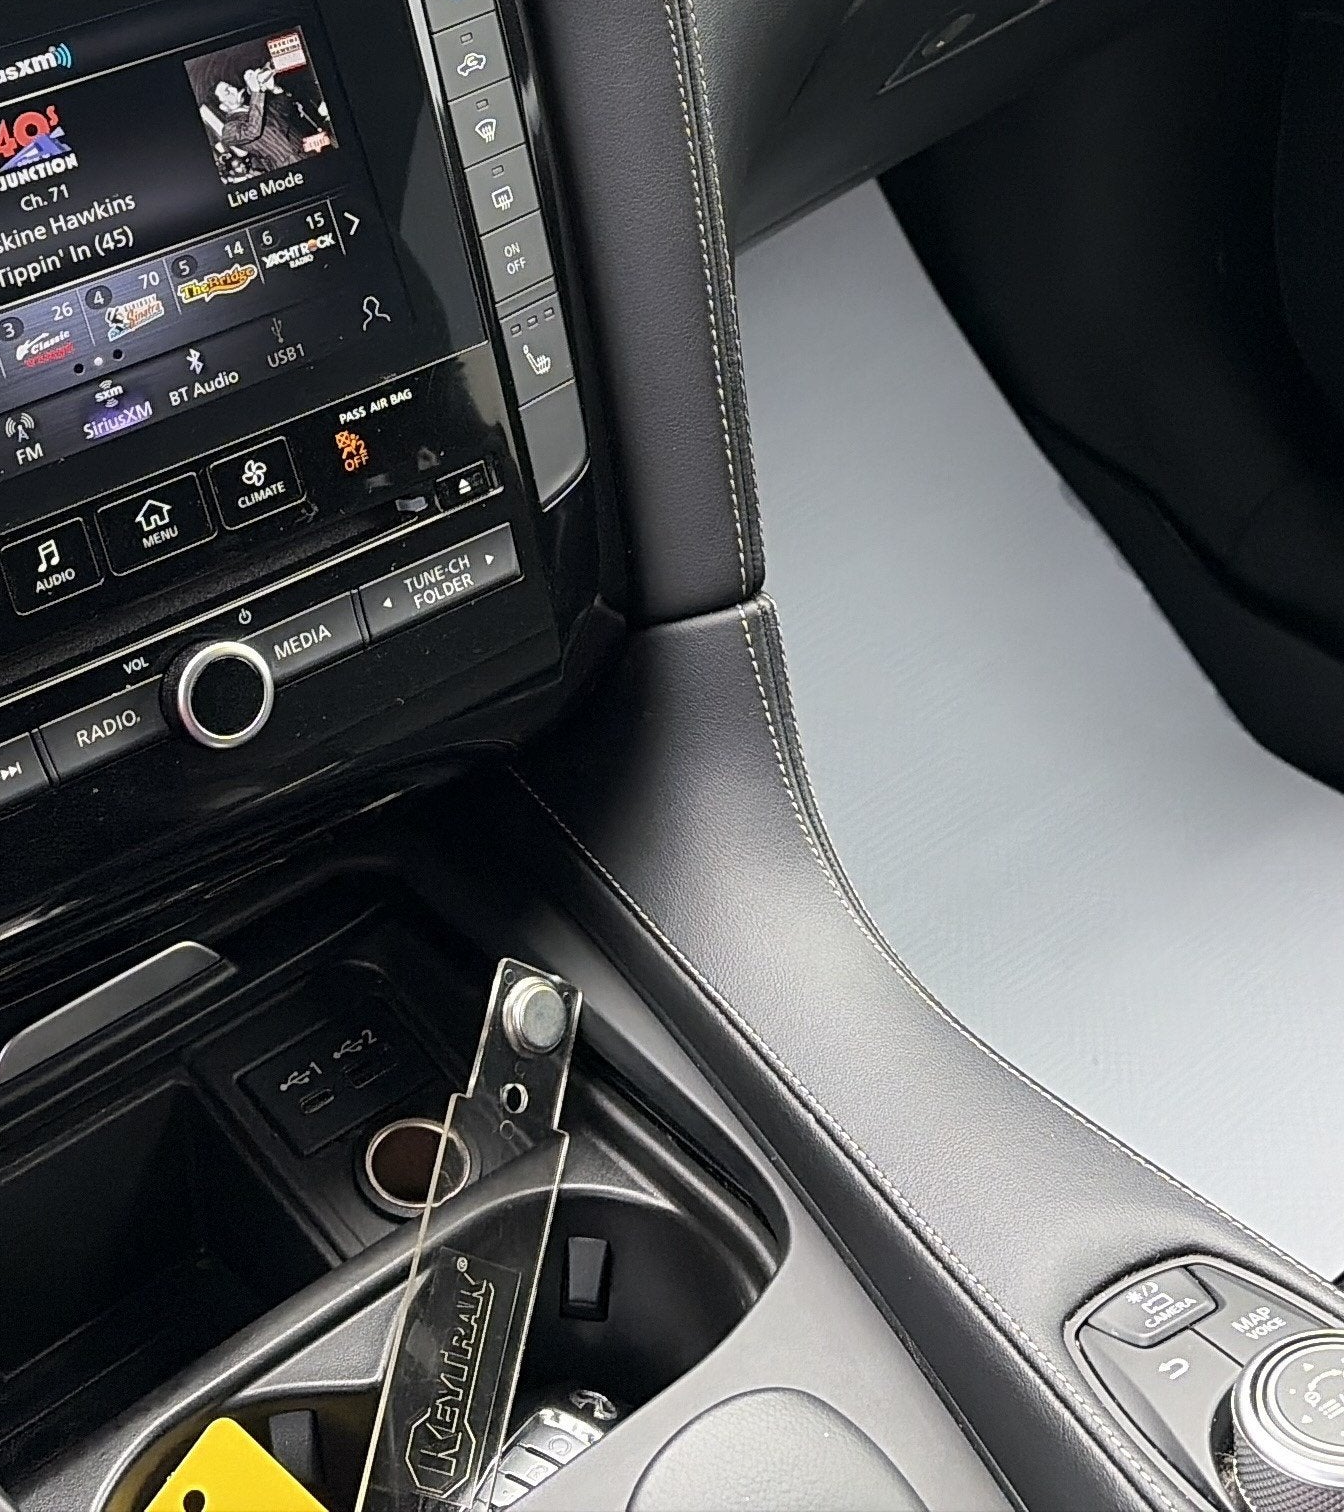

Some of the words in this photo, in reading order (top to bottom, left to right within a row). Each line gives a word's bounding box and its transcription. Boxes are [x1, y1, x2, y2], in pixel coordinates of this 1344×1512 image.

[0, 153, 79, 191] JUNCTION
[20, 192, 48, 212] Ch.
[48, 183, 69, 203] 71
[227, 188, 258, 208] Live
[259, 171, 305, 197] Mode
[50, 193, 136, 236] Hawkins
[306, 211, 325, 230] 15
[70, 243, 92, 264] In
[94, 226, 135, 257] (45)
[224, 241, 244, 259] 14
[262, 230, 273, 246] 6
[504, 241, 520, 257] ON
[178, 260, 190, 276] 5
[507, 256, 526, 275] OFF
[138, 271, 160, 290] 70
[93, 290, 105, 305] 4
[51, 301, 73, 321] 26
[3, 322, 15, 339] 3
[267, 344, 305, 369] USB1
[95, 385, 124, 403] sxm
[168, 386, 189, 406] BT
[193, 370, 240, 398] Audio
[339, 408, 367, 425] PASS
[370, 398, 388, 414] AIR
[389, 388, 413, 406] BAG
[83, 401, 153, 439] SiriusXM
[15, 443, 44, 465] FM
[344, 452, 370, 472] OFF
[237, 481, 286, 509] CLIMATE
[142, 525, 179, 549] MENU
[35, 568, 76, 594] AUDIO
[414, 573, 474, 609] FOLDER
[273, 624, 332, 660] MEDIA
[123, 657, 149, 674] VOL
[75, 709, 137, 748] RADIO
[362, 1029, 377, 1045] 2
[1144, 1297, 1197, 1328] CAMERA
[1231, 1306, 1271, 1333] MAP
[1246, 1316, 1287, 1340] VOICE
